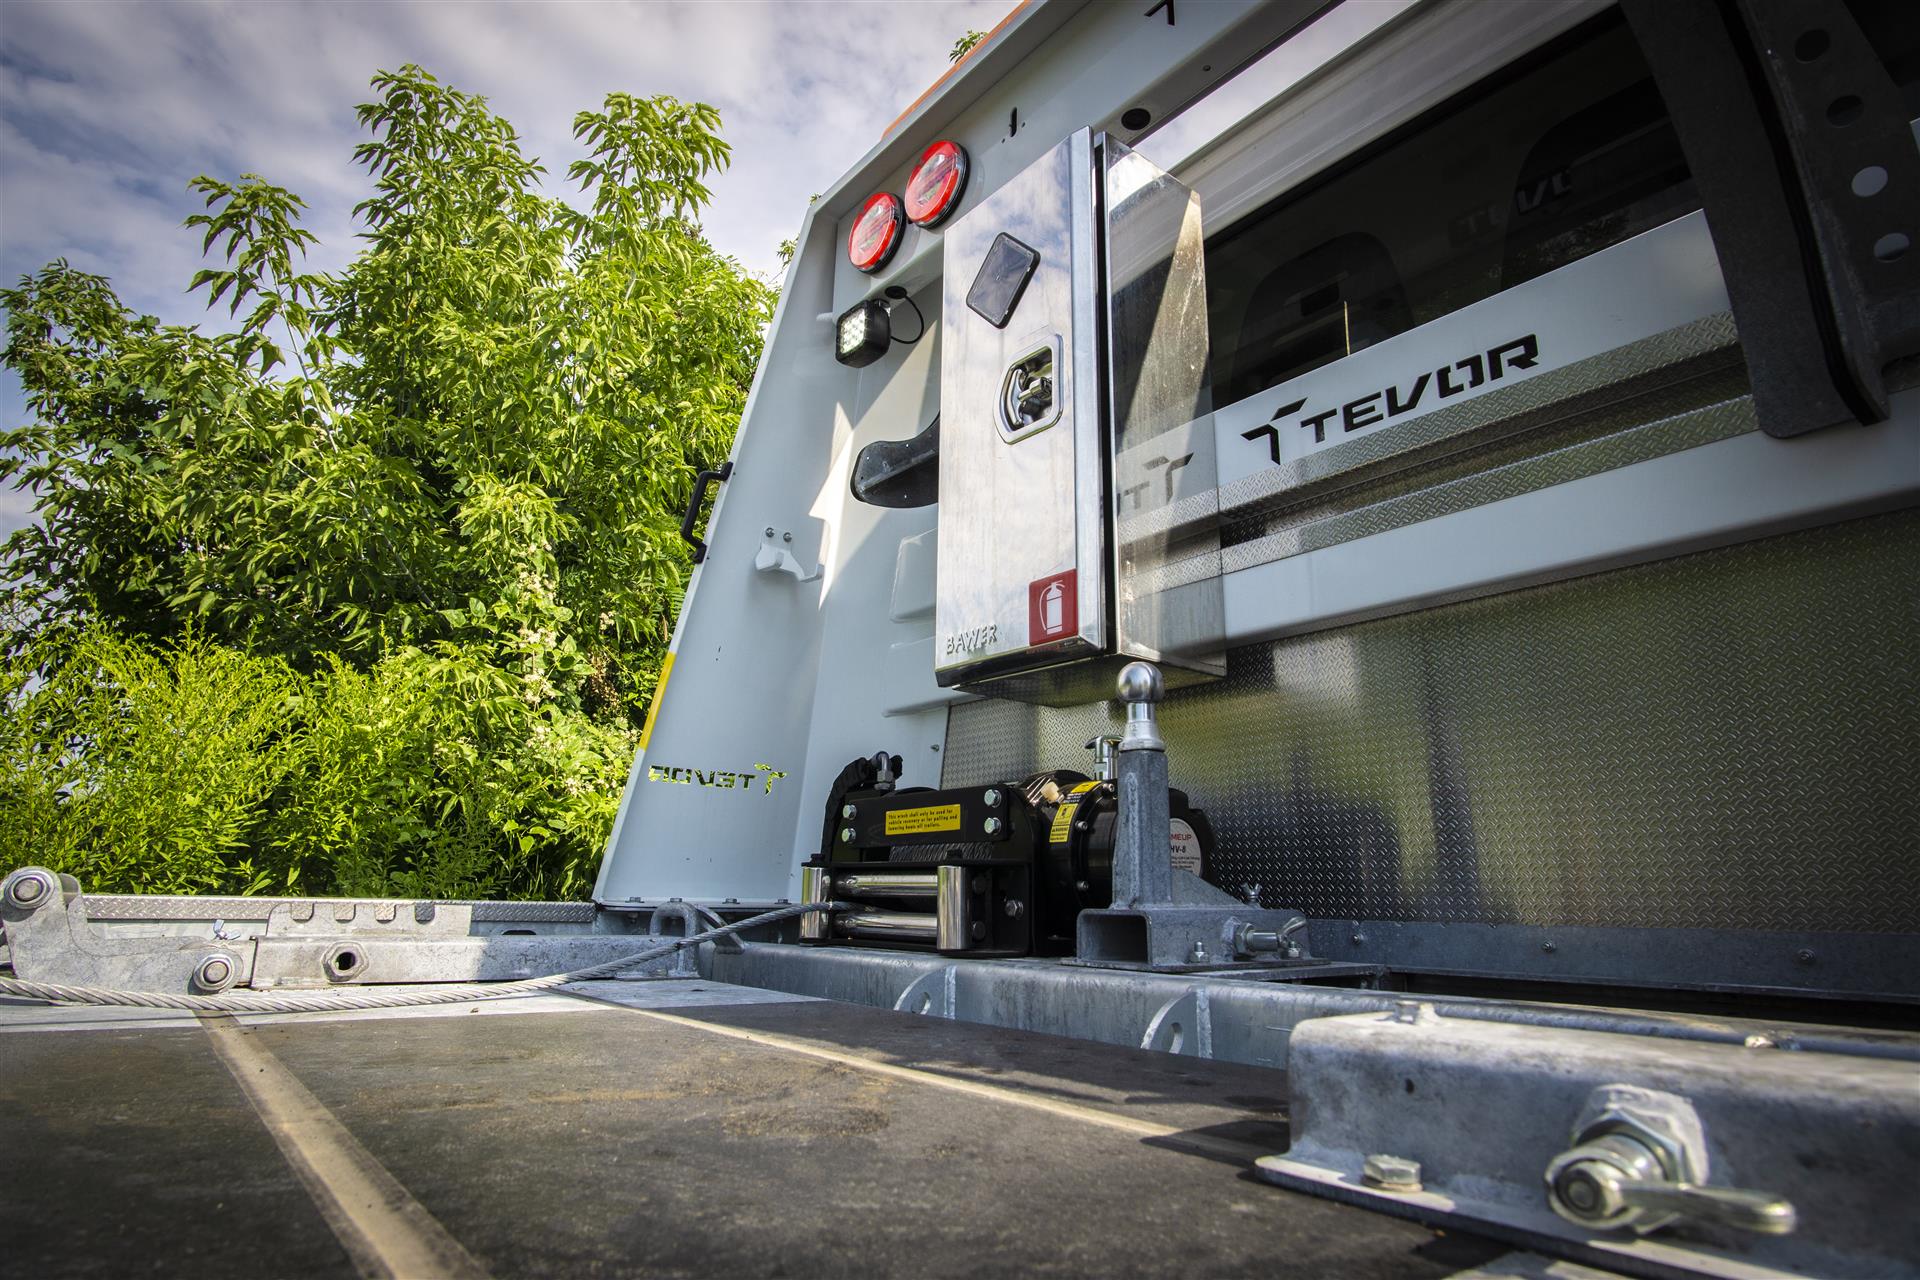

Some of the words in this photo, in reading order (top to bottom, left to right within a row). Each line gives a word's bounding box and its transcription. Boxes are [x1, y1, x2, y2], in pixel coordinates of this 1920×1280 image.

[1301, 333, 1540, 444] TEVOR
[946, 624, 998, 655] BAWER
[1169, 833, 1192, 841] MEUP
